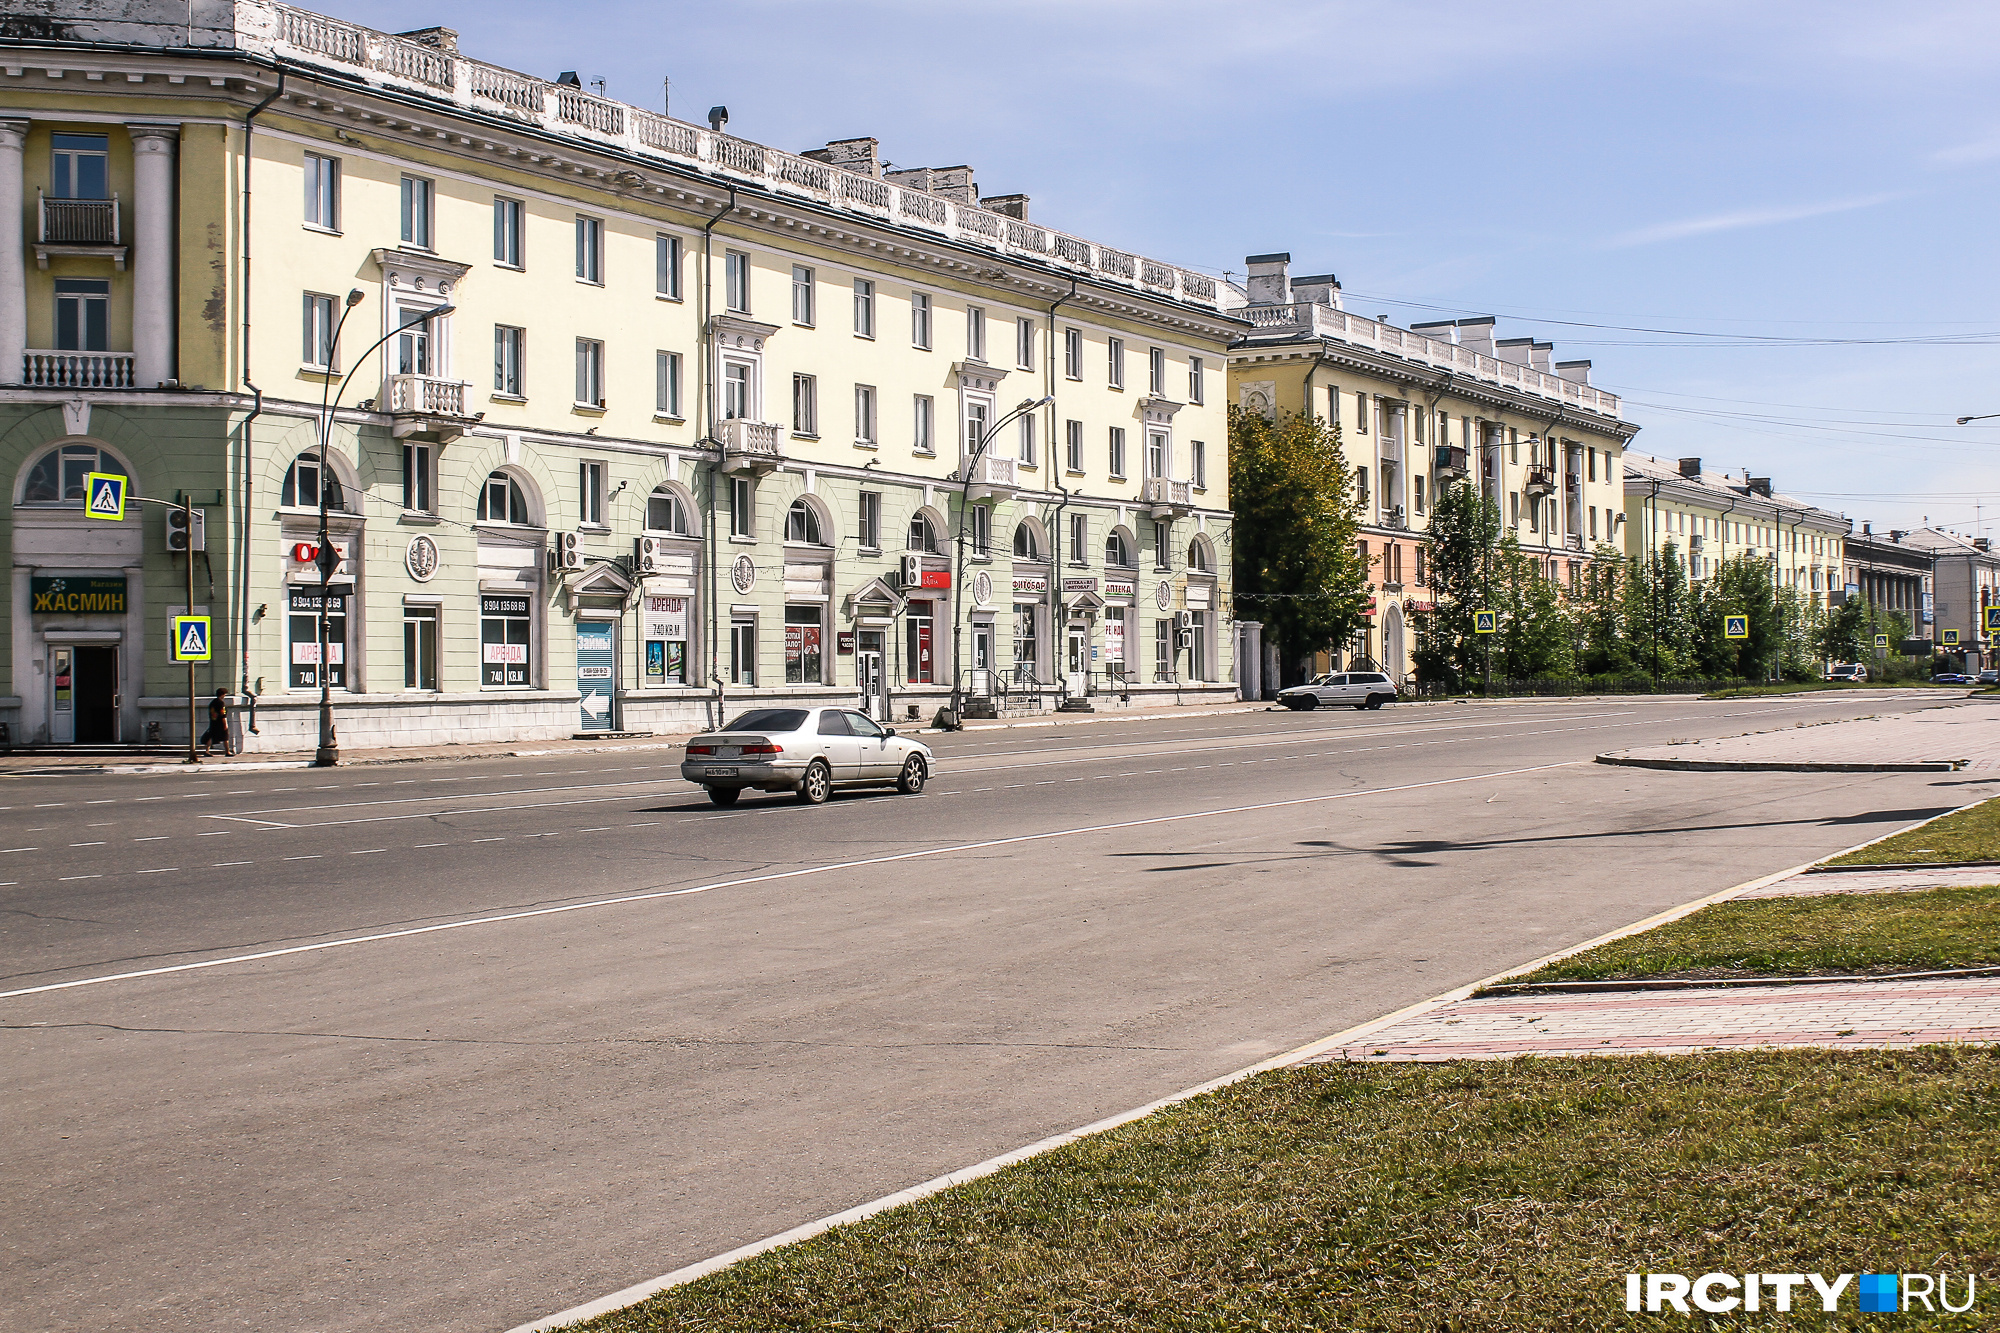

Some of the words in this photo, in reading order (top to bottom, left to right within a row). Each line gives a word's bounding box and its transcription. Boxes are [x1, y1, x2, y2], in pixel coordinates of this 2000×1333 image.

[91, 580, 123, 588] Магазин
[1105, 584, 1131, 593] АПТЕКА
[34, 593, 124, 611] ЖАСМИН
[292, 596, 298, 607] 8
[298, 597, 311, 608] 904
[333, 598, 341, 608] 69
[484, 600, 488, 611] 8
[489, 600, 499, 611] 904
[500, 601, 510, 611] 135
[510, 601, 518, 611] 68
[518, 601, 526, 611] 69
[651, 597, 682, 614] АРЕНДА
[653, 624, 664, 636] 740
[577, 634, 611, 650] Займы
[490, 646, 522, 662] АРЕНДА
[300, 671, 314, 684] 740
[490, 671, 503, 682] 740
[508, 671, 524, 682] КВ.М
